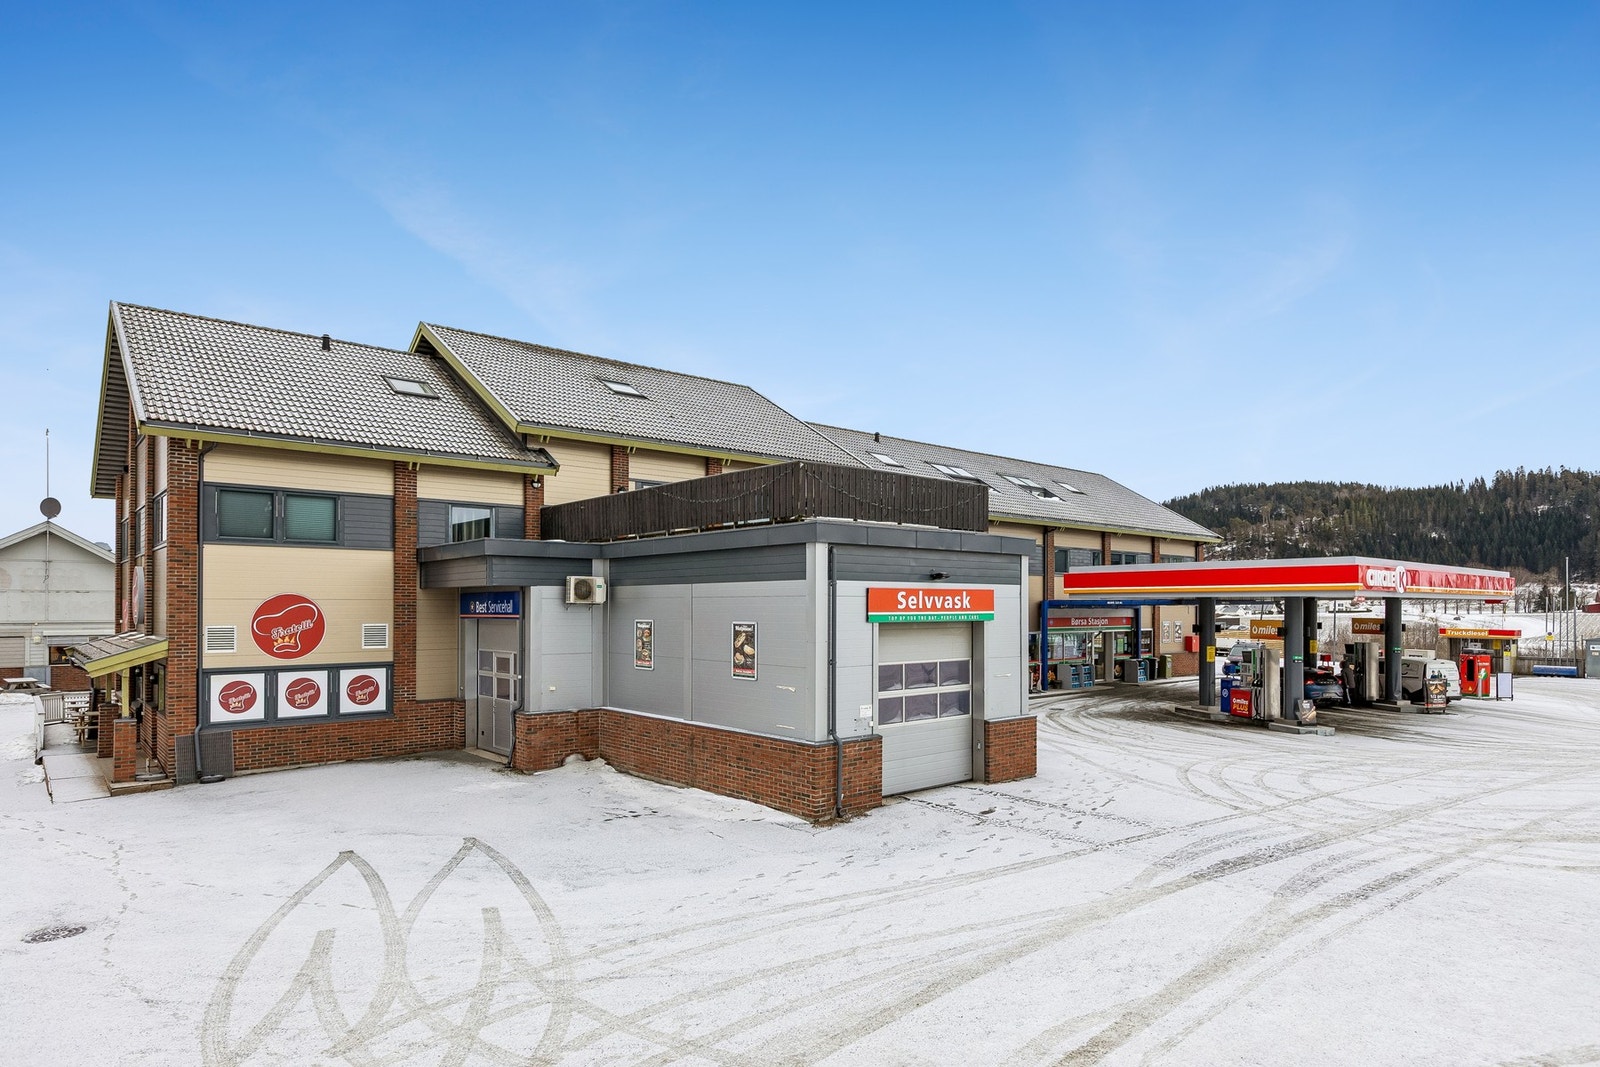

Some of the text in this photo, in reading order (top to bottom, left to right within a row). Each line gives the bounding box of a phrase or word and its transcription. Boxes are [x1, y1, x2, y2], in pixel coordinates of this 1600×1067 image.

[1366, 569, 1396, 587] CIRCLE
[476, 601, 487, 613] Best
[897, 590, 971, 609] Selvvask
[1088, 617, 1108, 626] Stasjon
[271, 619, 314, 640] Fratelli
[1232, 704, 1249, 712] PLUS
